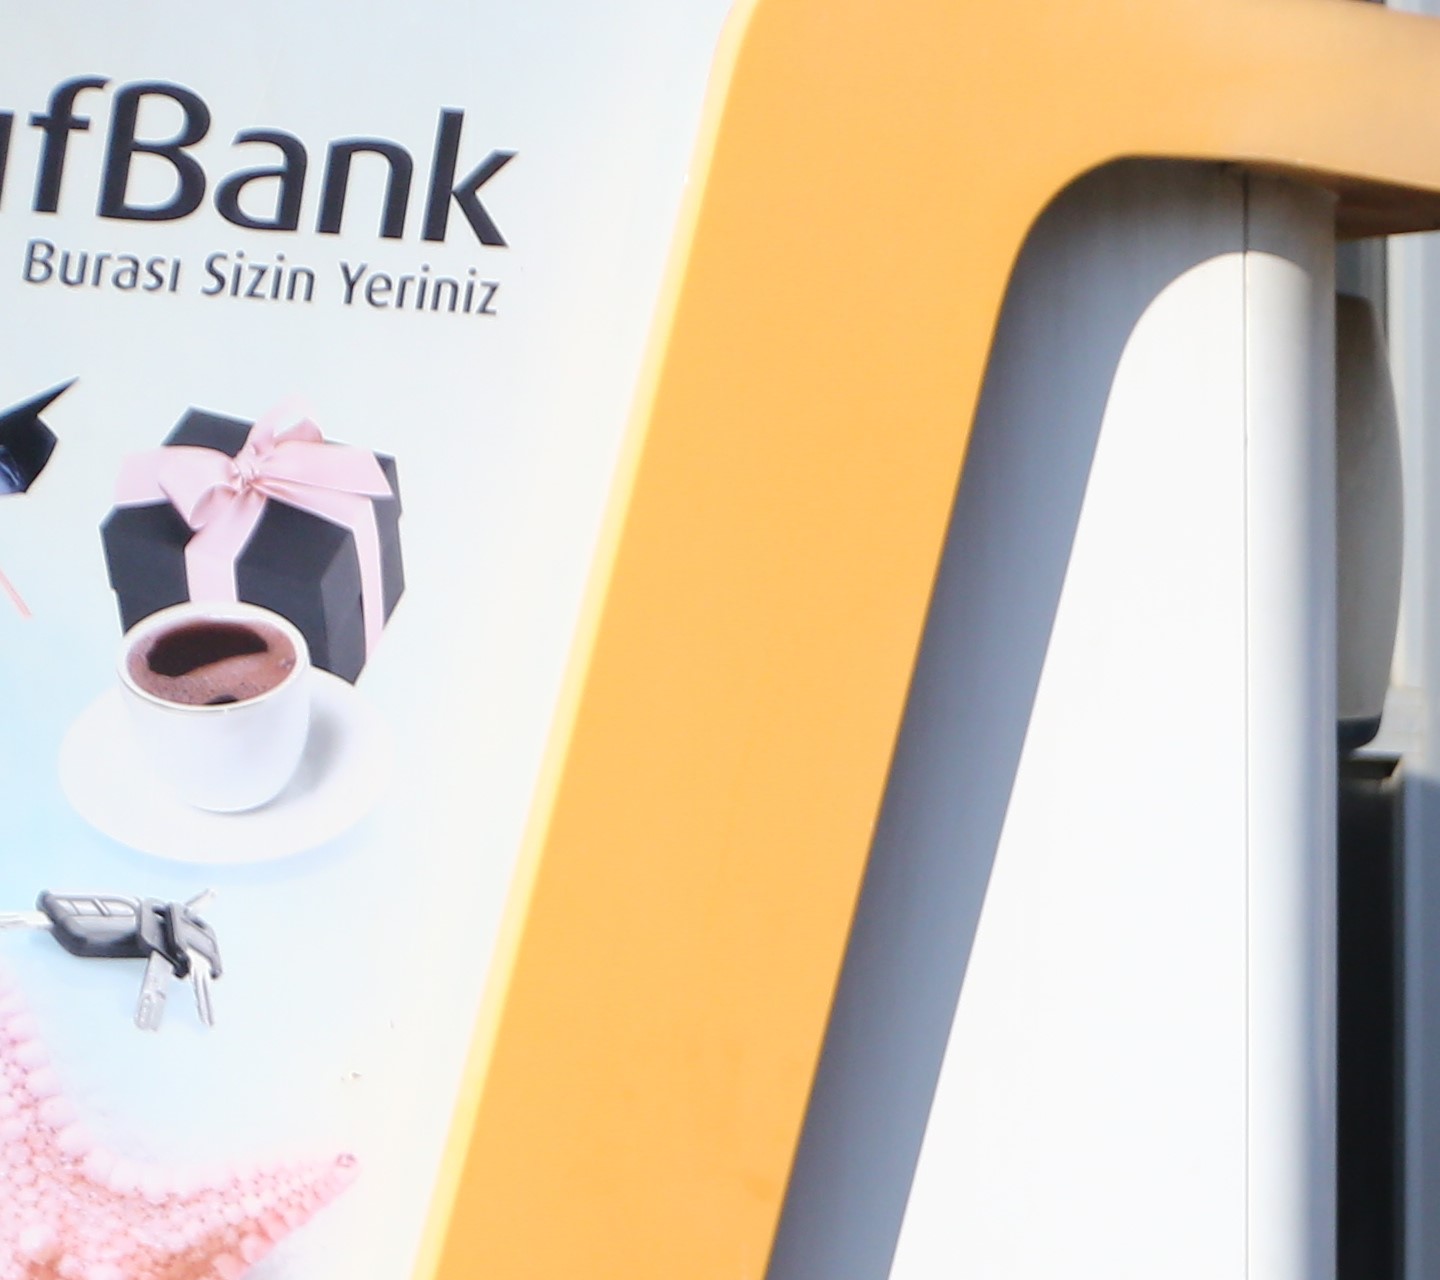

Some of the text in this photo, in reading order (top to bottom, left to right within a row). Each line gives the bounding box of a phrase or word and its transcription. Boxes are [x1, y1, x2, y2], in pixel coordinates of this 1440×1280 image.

[22, 238, 501, 317] Burası Sizin Yeriniz
